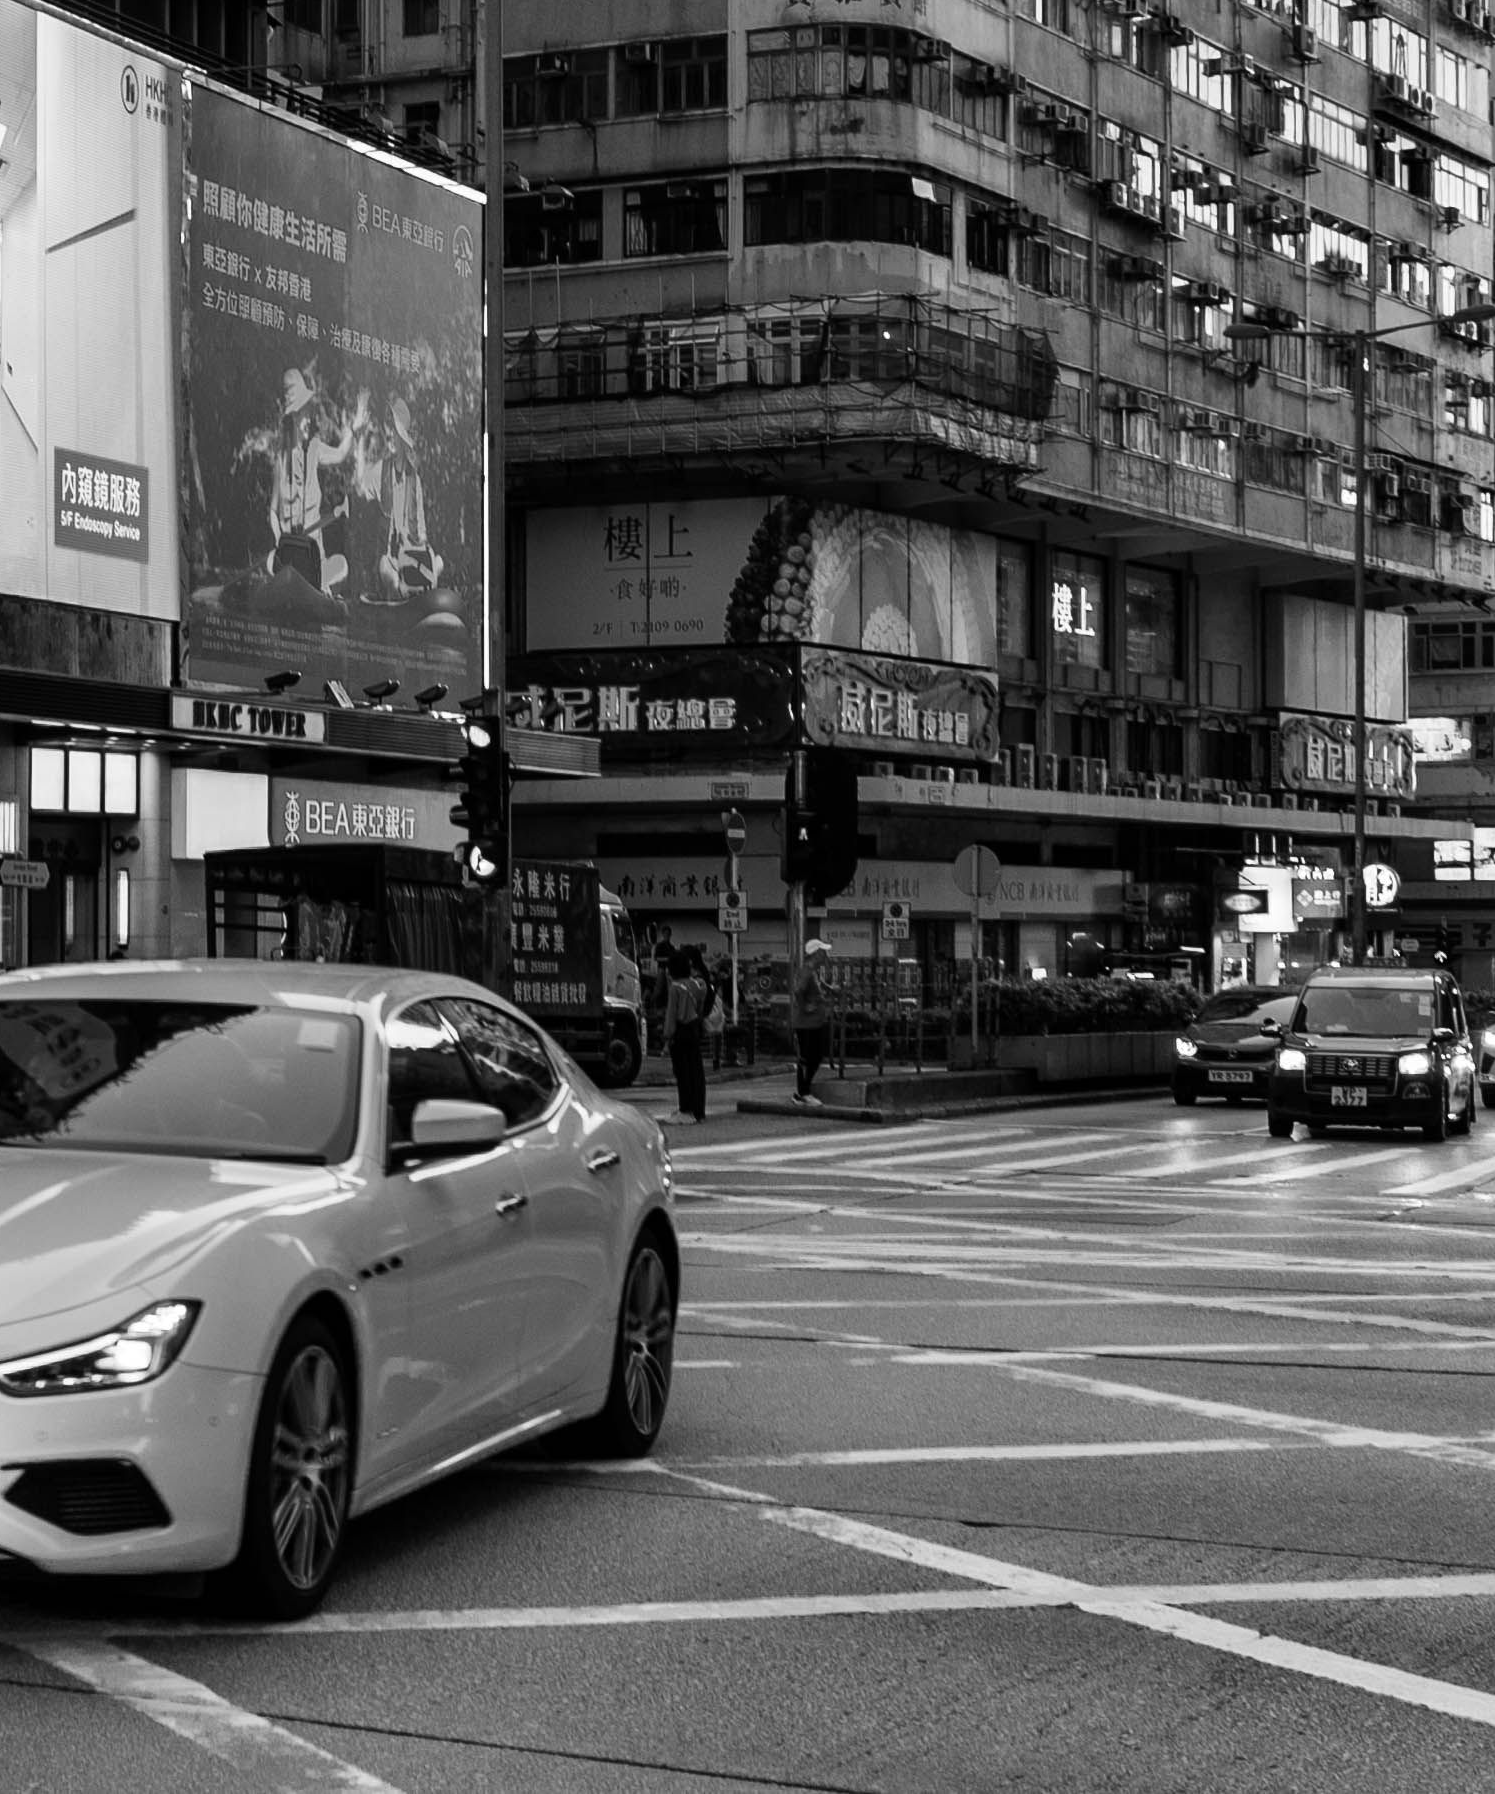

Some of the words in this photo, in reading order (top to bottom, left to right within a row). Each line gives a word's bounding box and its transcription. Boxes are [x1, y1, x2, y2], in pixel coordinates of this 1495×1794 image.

[202, 179, 348, 264] 照顧你健康生活所需
[372, 204, 401, 238] BEA
[202, 243, 250, 282] 東亞銀行
[265, 264, 312, 303] 友邦香港
[61, 462, 141, 518] 內窺鏡服務
[74, 512, 113, 539] Endoscopy
[114, 519, 141, 542] Service
[603, 513, 693, 563] 樓上
[592, 621, 614, 635] 2/F
[673, 619, 704, 632] 0690
[1051, 581, 1096, 637] 樓上
[192, 700, 243, 732] HKHC
[247, 706, 306, 737] TOWER
[304, 799, 351, 836] BEA
[352, 803, 416, 840] 東亞銀行
